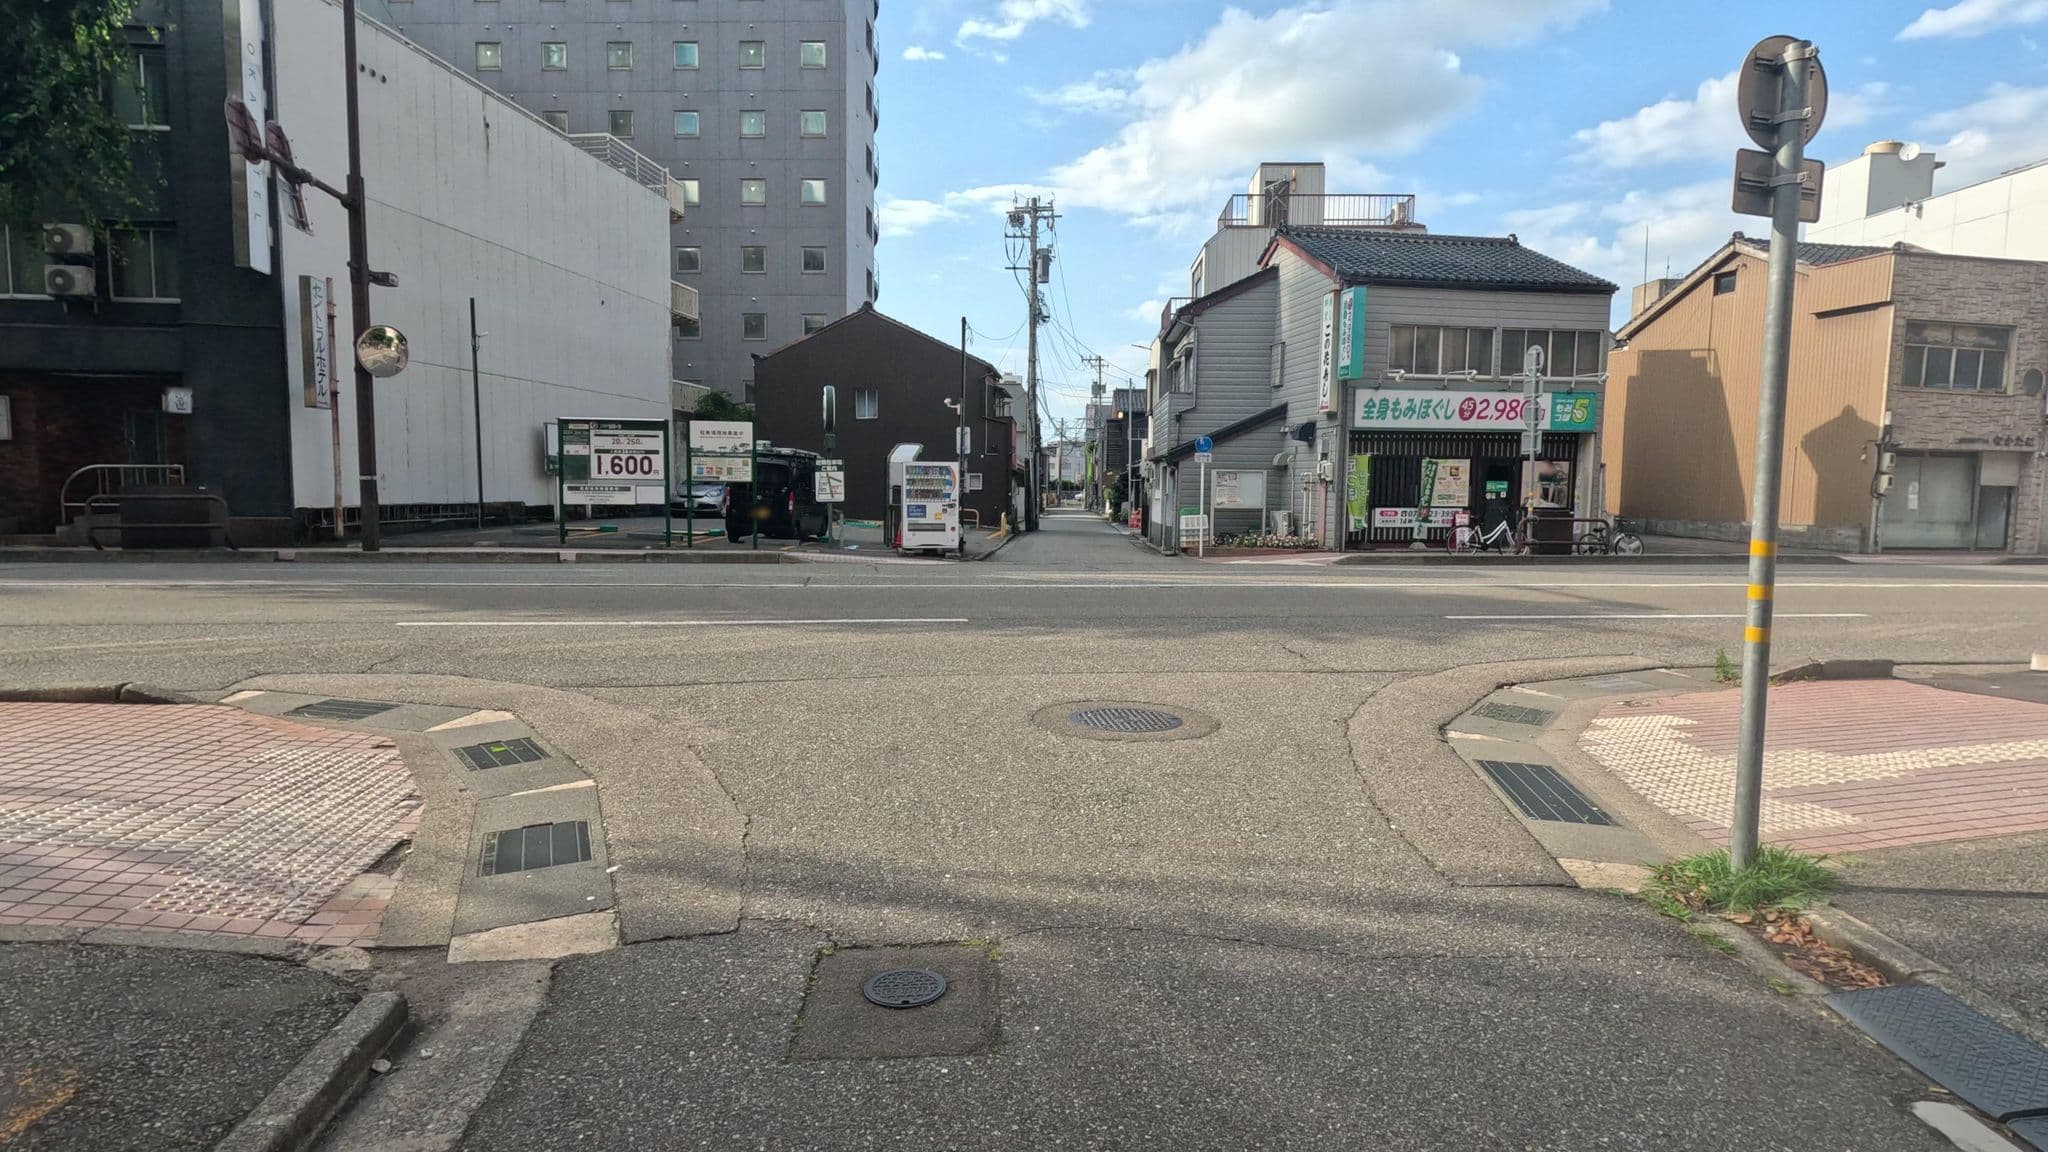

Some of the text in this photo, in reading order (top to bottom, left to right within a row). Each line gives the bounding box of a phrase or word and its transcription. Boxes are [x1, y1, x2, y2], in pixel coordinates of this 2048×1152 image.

[311, 281, 329, 398] セントラルホテル
[1361, 396, 1456, 421] 全身もみほぐし
[1461, 400, 1475, 411] 45
[1572, 398, 1590, 423] 5
